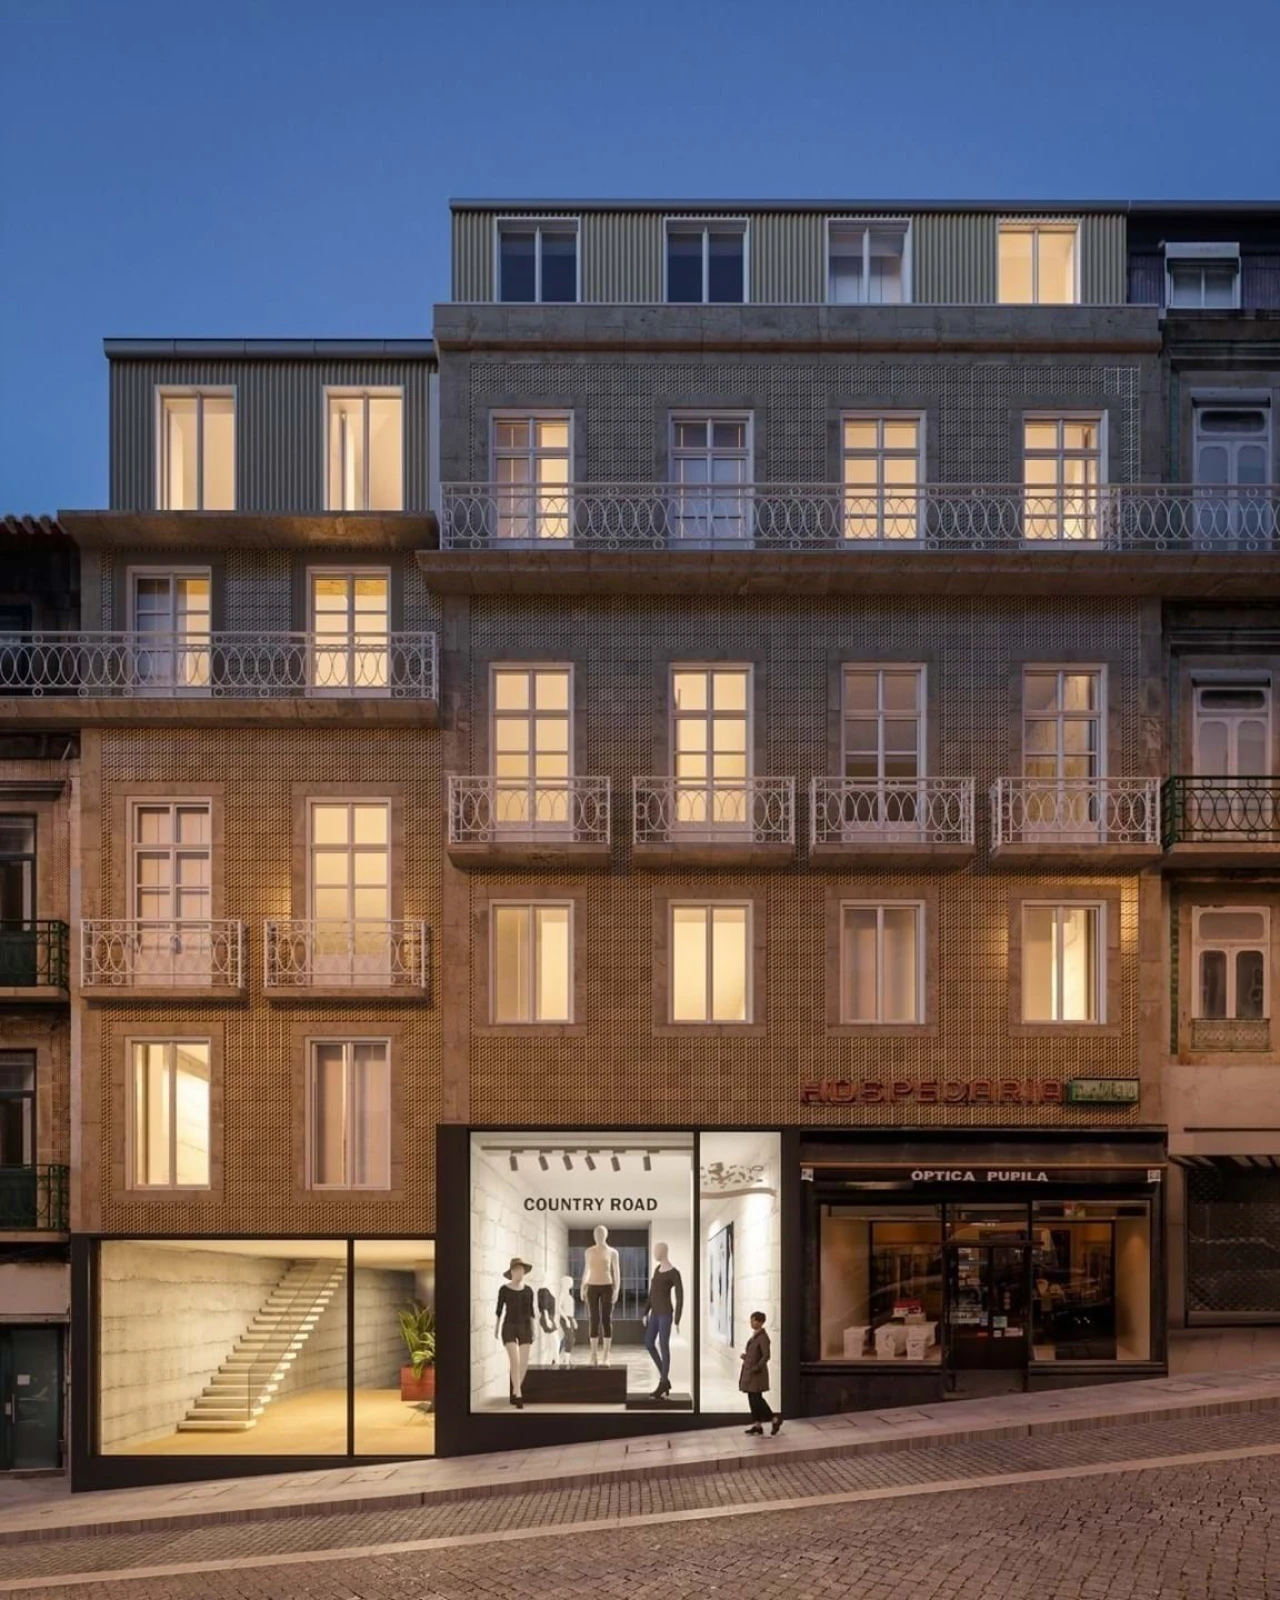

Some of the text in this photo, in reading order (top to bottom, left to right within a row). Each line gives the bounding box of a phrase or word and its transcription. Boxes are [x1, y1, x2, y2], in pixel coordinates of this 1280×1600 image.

[801, 1079, 1063, 1105] HOSPEDARIA
[986, 1170, 1049, 1182] PUPILA
[523, 1197, 658, 1211] COUNTRY ROAD
